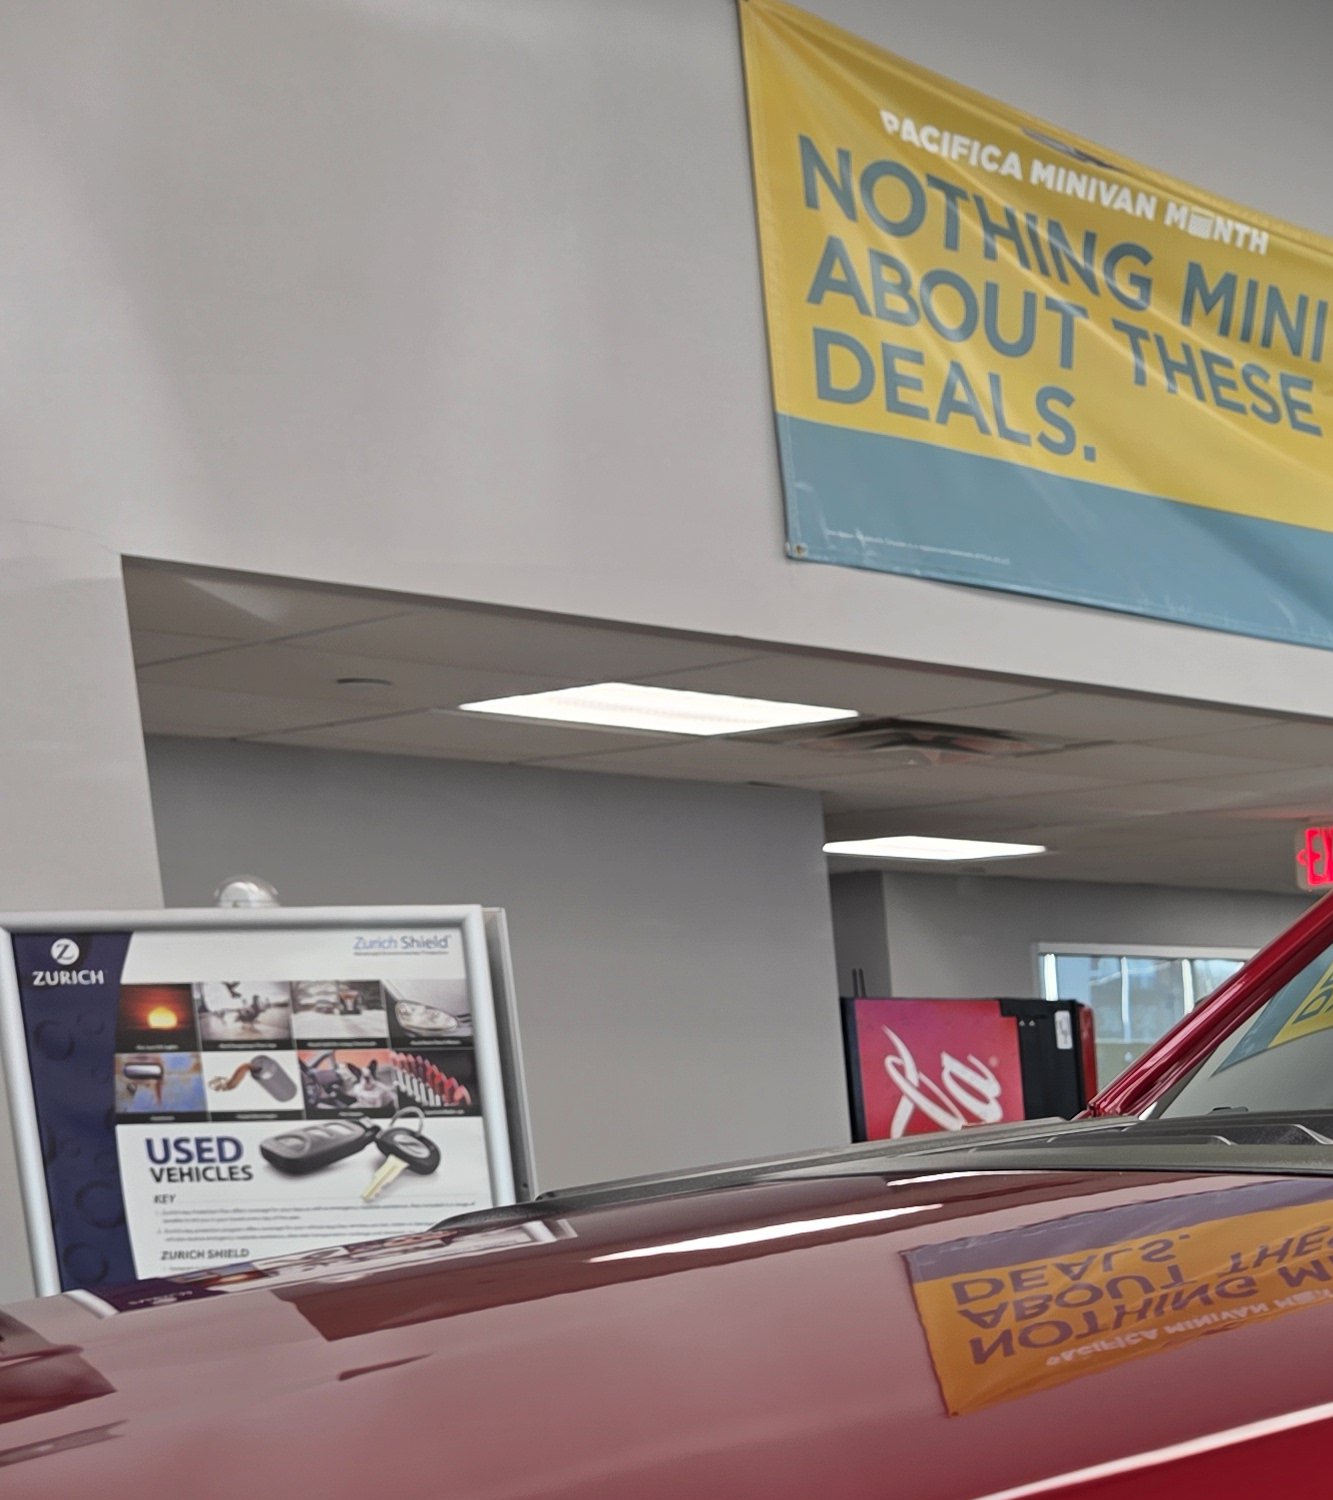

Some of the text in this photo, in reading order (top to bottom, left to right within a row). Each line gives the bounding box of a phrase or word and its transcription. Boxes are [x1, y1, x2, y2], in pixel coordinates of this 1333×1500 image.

[880, 110, 1270, 256] PACIFICA MINIVAN MNTH
[798, 133, 1329, 363] NOTHING MINI
[805, 235, 1323, 437] ABOUT THESE
[811, 327, 1096, 463] DEALS.
[353, 935, 398, 950] Zurich
[32, 969, 104, 986] ZURICH
[145, 1136, 243, 1164] USED
[150, 1164, 253, 1182] VEHICLES
[154, 1194, 176, 1204] KEY
[161, 1248, 250, 1260] ZURICH SHIELD
